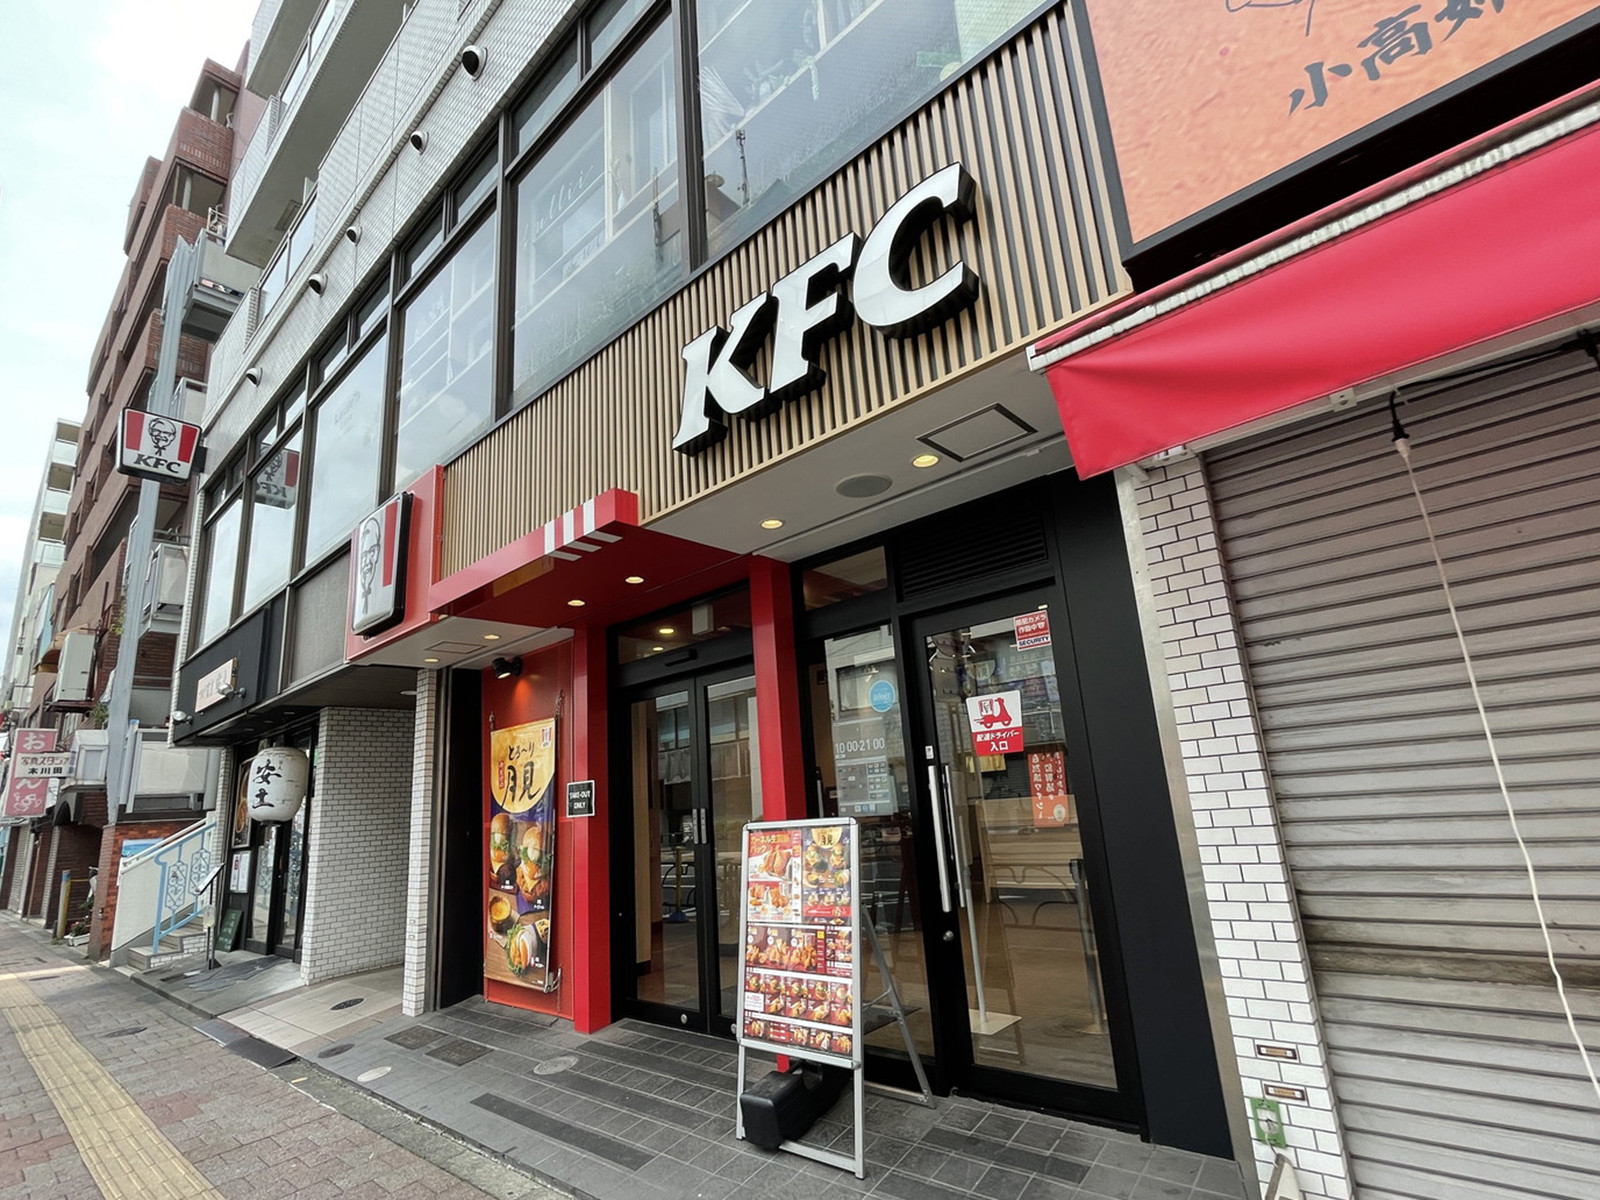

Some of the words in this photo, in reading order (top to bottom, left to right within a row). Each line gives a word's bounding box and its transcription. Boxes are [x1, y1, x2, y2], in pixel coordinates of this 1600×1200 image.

[672, 161, 976, 455] KFC
[134, 453, 181, 474] KFC
[1018, 636, 1050, 647] SECURITY
[976, 730, 1020, 742] 配達ドライバー
[990, 740, 1009, 752] 入口
[502, 761, 541, 808] 月見
[569, 790, 591, 800] TAKE-OUT
[573, 802, 586, 810] ONLY
